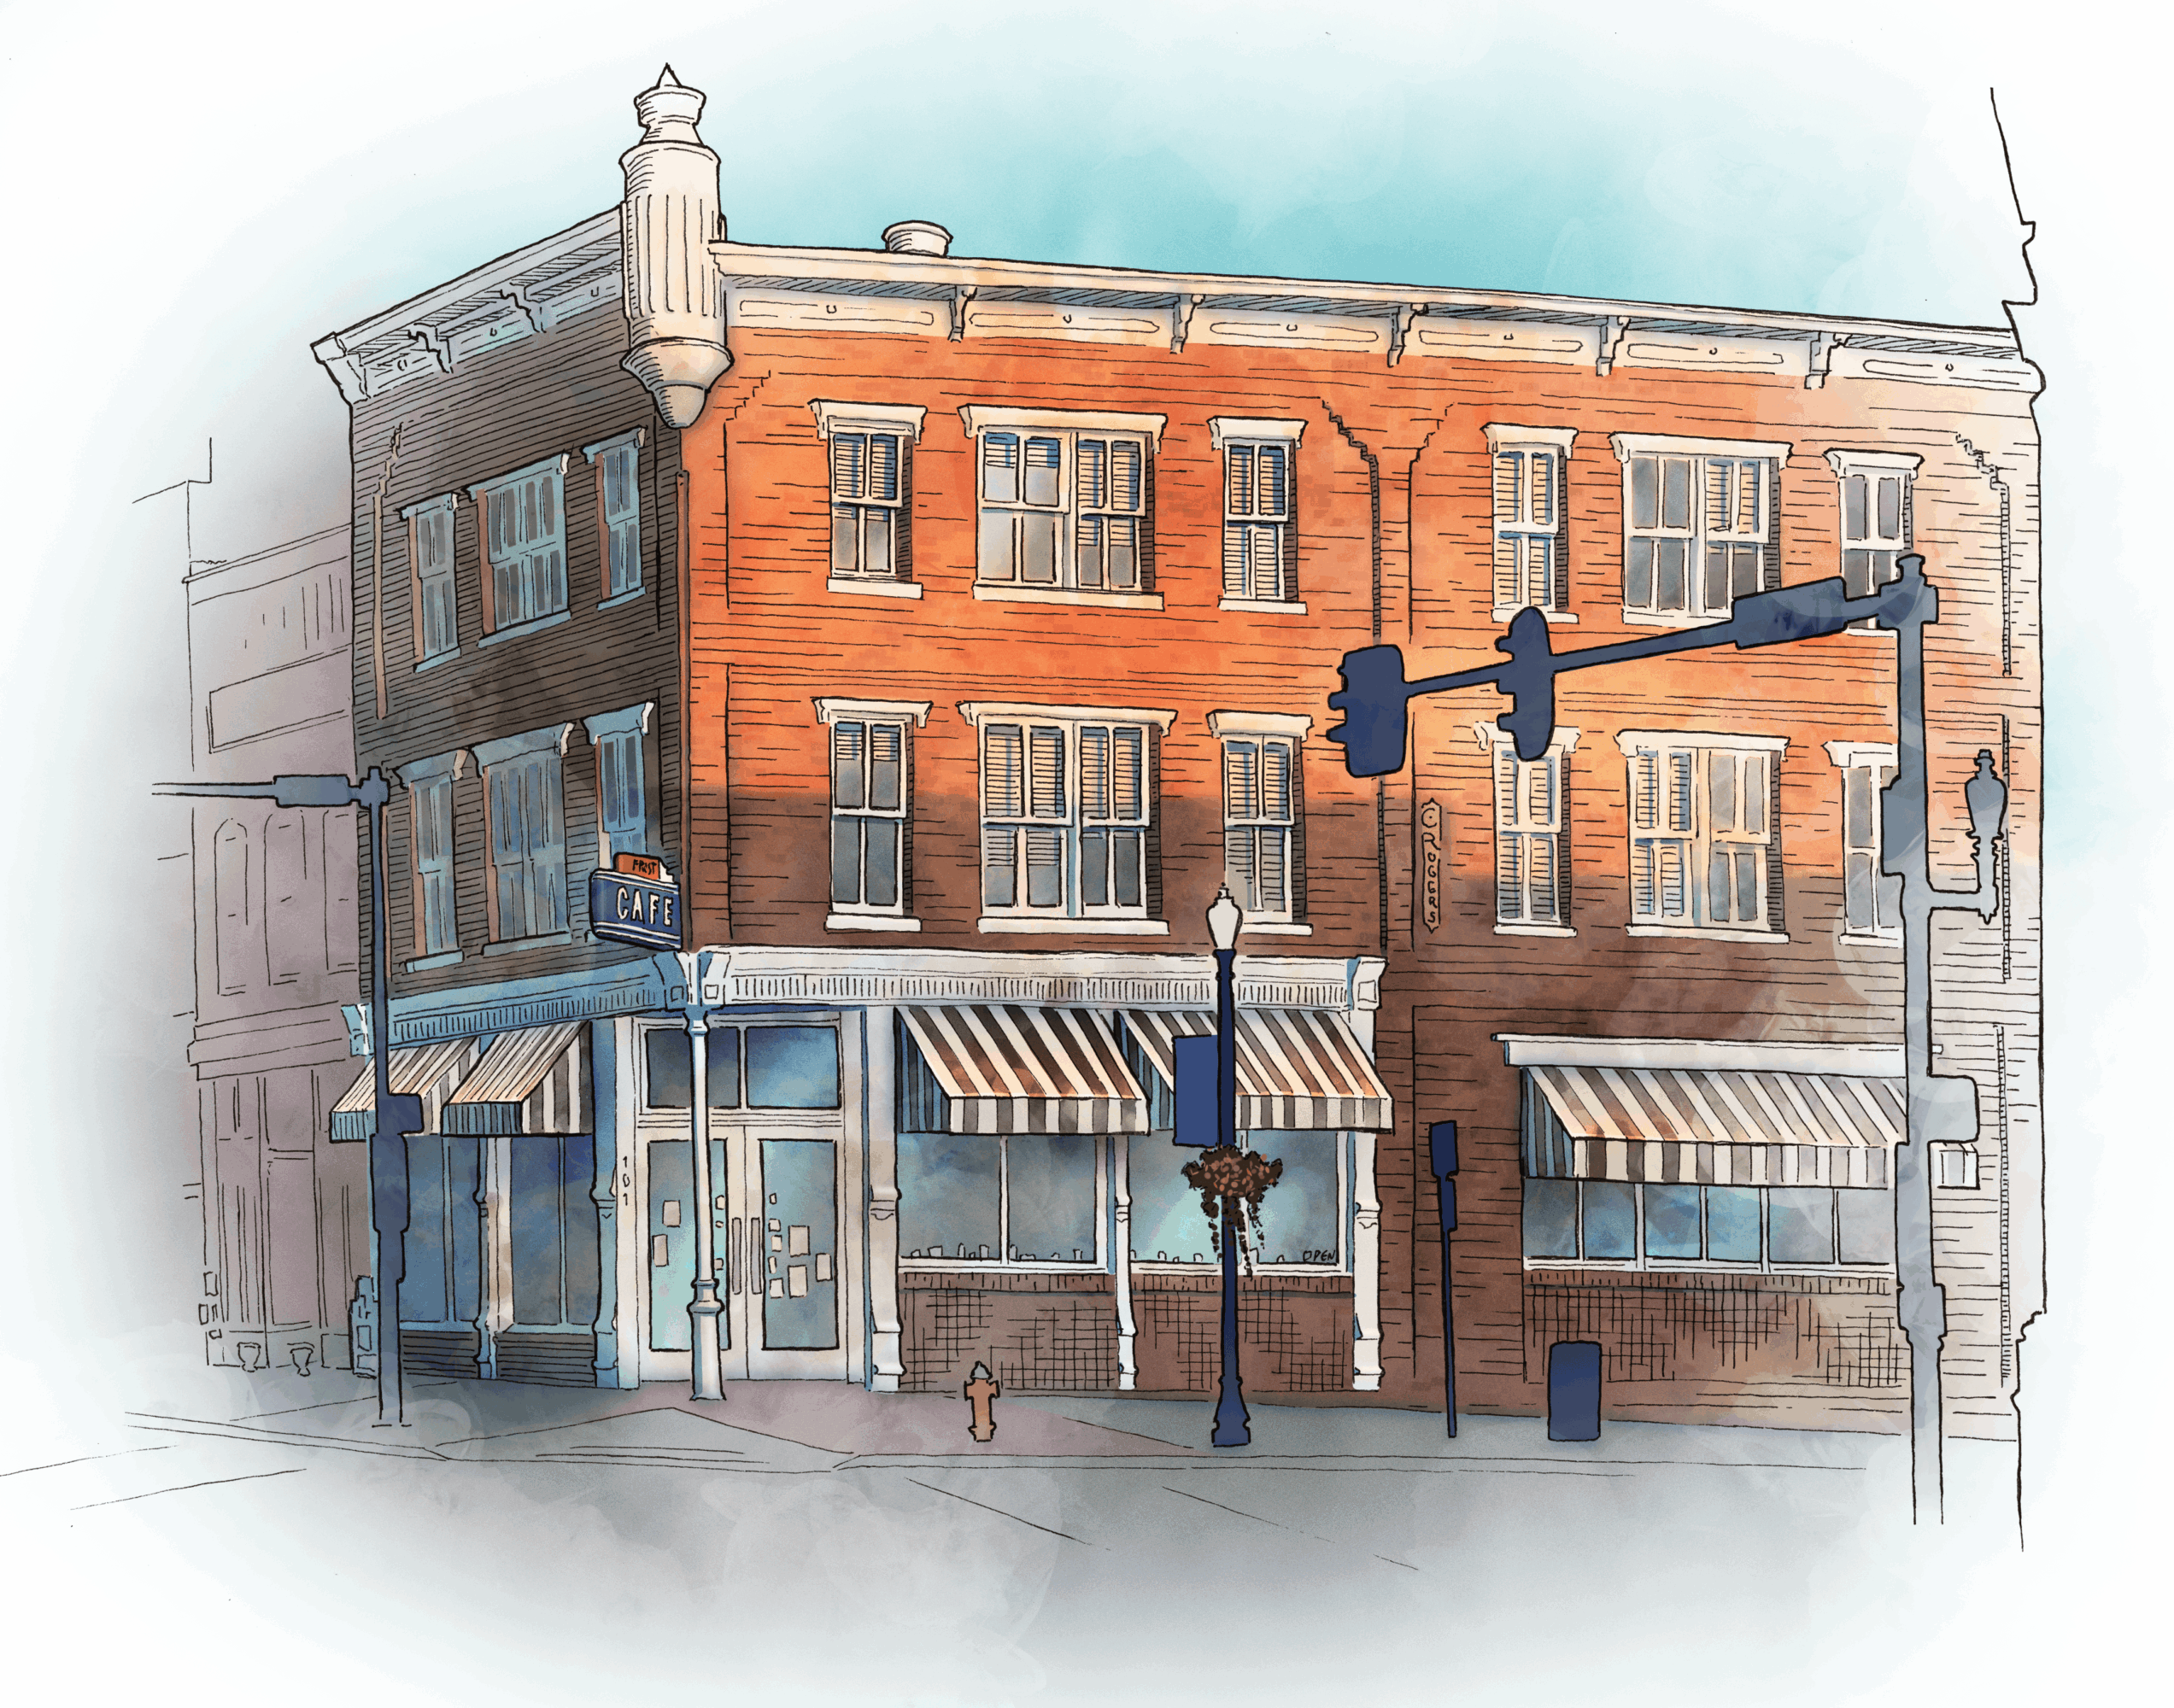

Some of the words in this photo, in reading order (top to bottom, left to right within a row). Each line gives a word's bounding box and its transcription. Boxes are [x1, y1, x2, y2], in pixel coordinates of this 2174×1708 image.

[616, 886, 673, 927] CAFE
[622, 1155, 630, 1206] 101
[1303, 1249, 1336, 1261] OPEN
